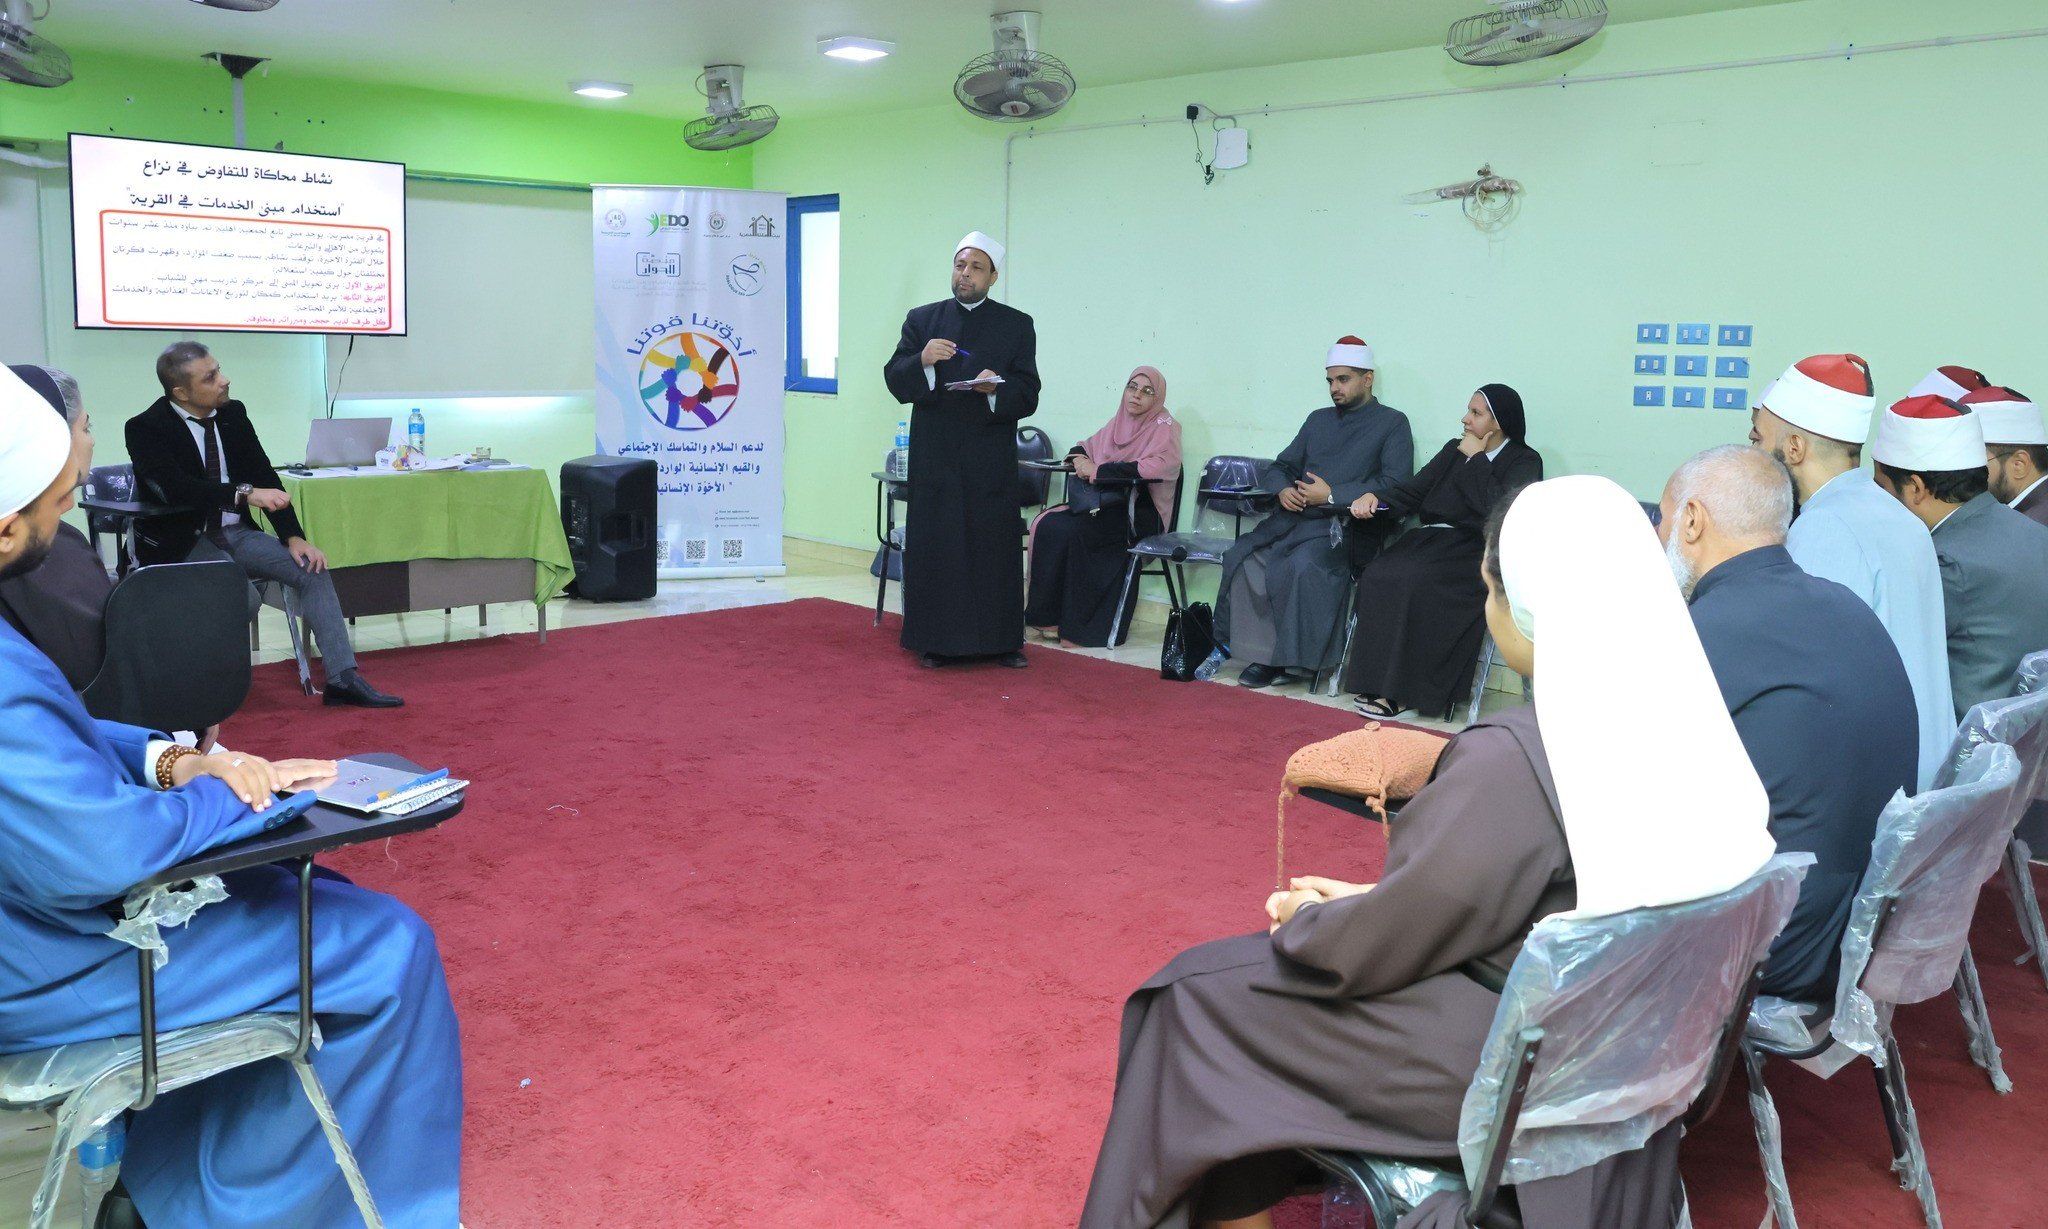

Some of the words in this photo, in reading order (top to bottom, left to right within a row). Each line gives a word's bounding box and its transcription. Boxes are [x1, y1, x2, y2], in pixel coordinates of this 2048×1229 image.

[142, 158, 171, 177] نزاع
[177, 160, 192, 175] في
[197, 165, 249, 179] للتفاوض
[253, 166, 297, 182] محاكاة
[301, 172, 333, 185] نشاط
[177, 193, 193, 209] في
[198, 195, 254, 211] الخدمات
[666, 440, 707, 455] والتماسك
[710, 441, 738, 454] السلام
[741, 441, 764, 453] لدعم
[657, 461, 686, 475] الوارد
[689, 461, 729, 475] الإنسانية
[732, 461, 760, 475] والقيم
[657, 482, 693, 496] الإنساني
